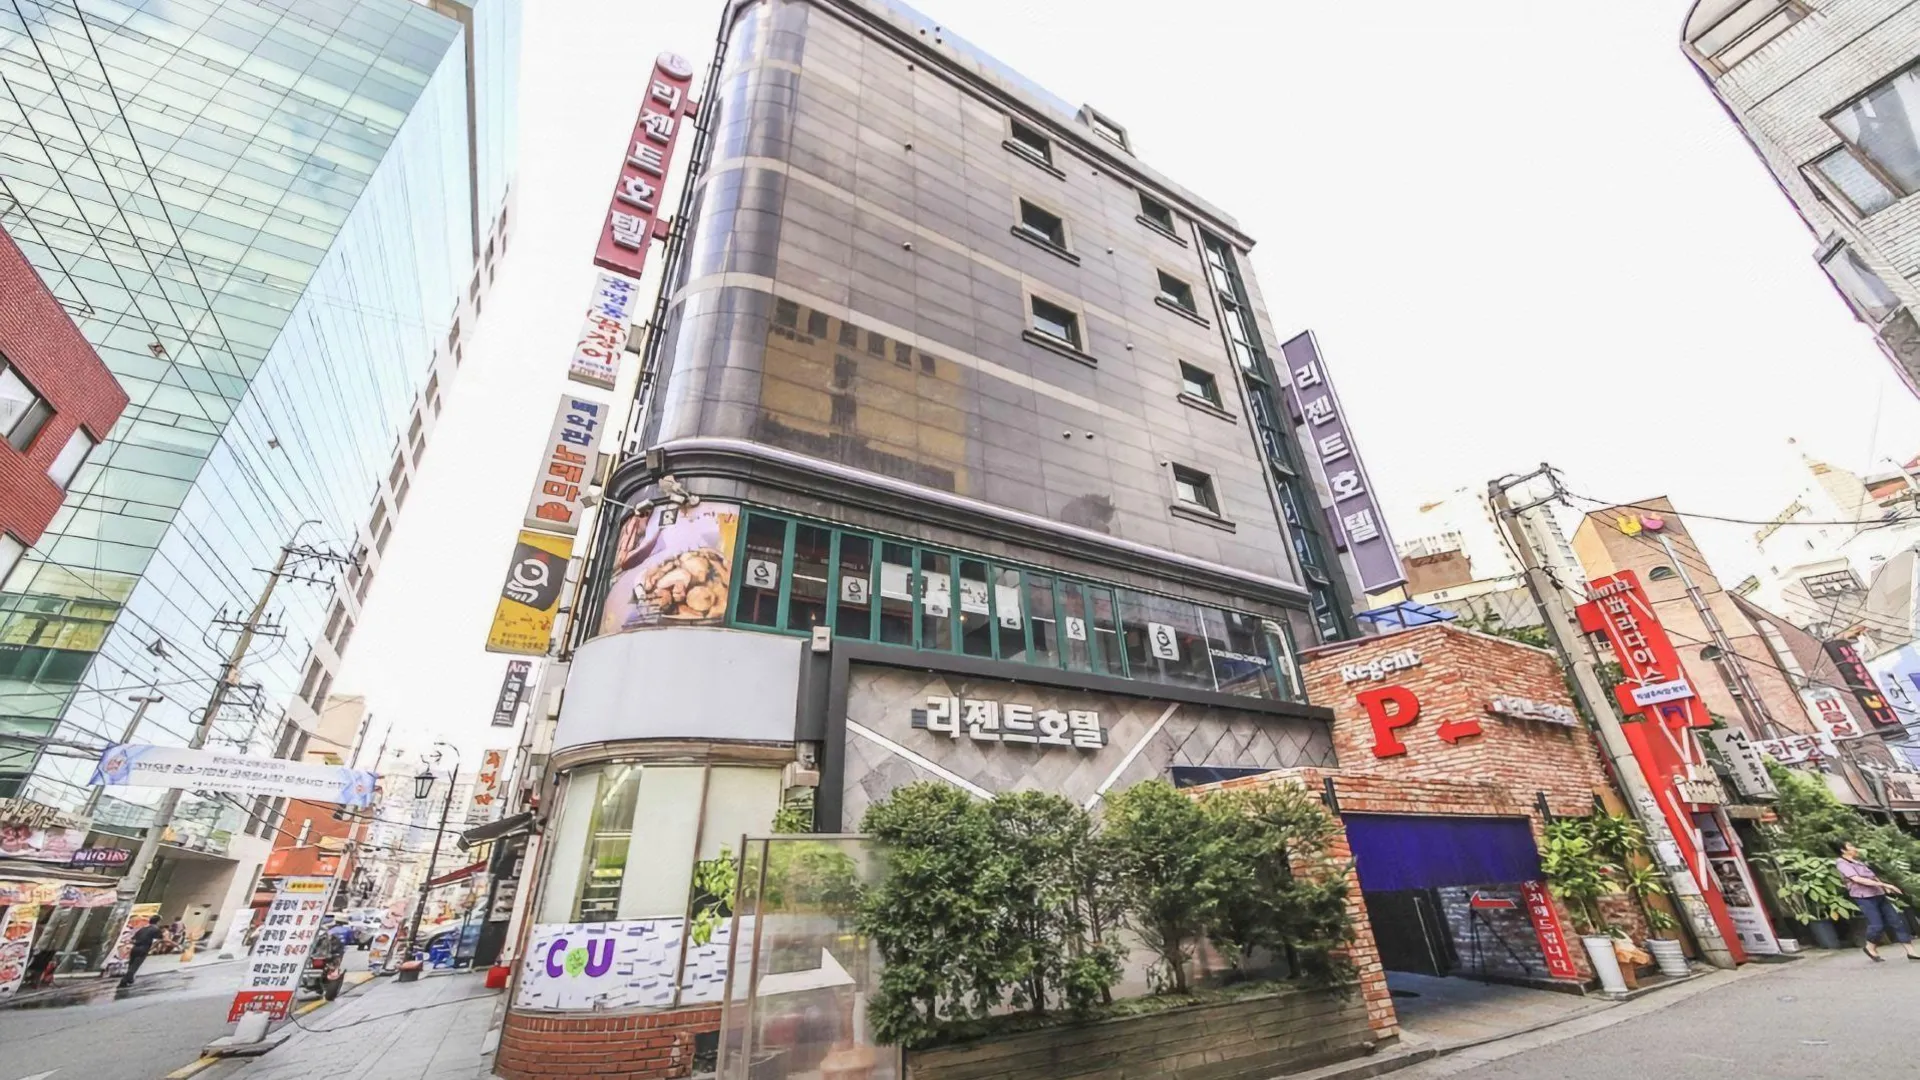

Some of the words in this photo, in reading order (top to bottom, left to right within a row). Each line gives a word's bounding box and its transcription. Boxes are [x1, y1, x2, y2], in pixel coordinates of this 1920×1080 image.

[610, 79, 682, 254] 리젠트호텔
[1295, 360, 1380, 545] 리젠트호텔
[1339, 648, 1423, 684] Regent
[927, 696, 1104, 749] 리젠트호텔
[1355, 685, 1421, 759] P
